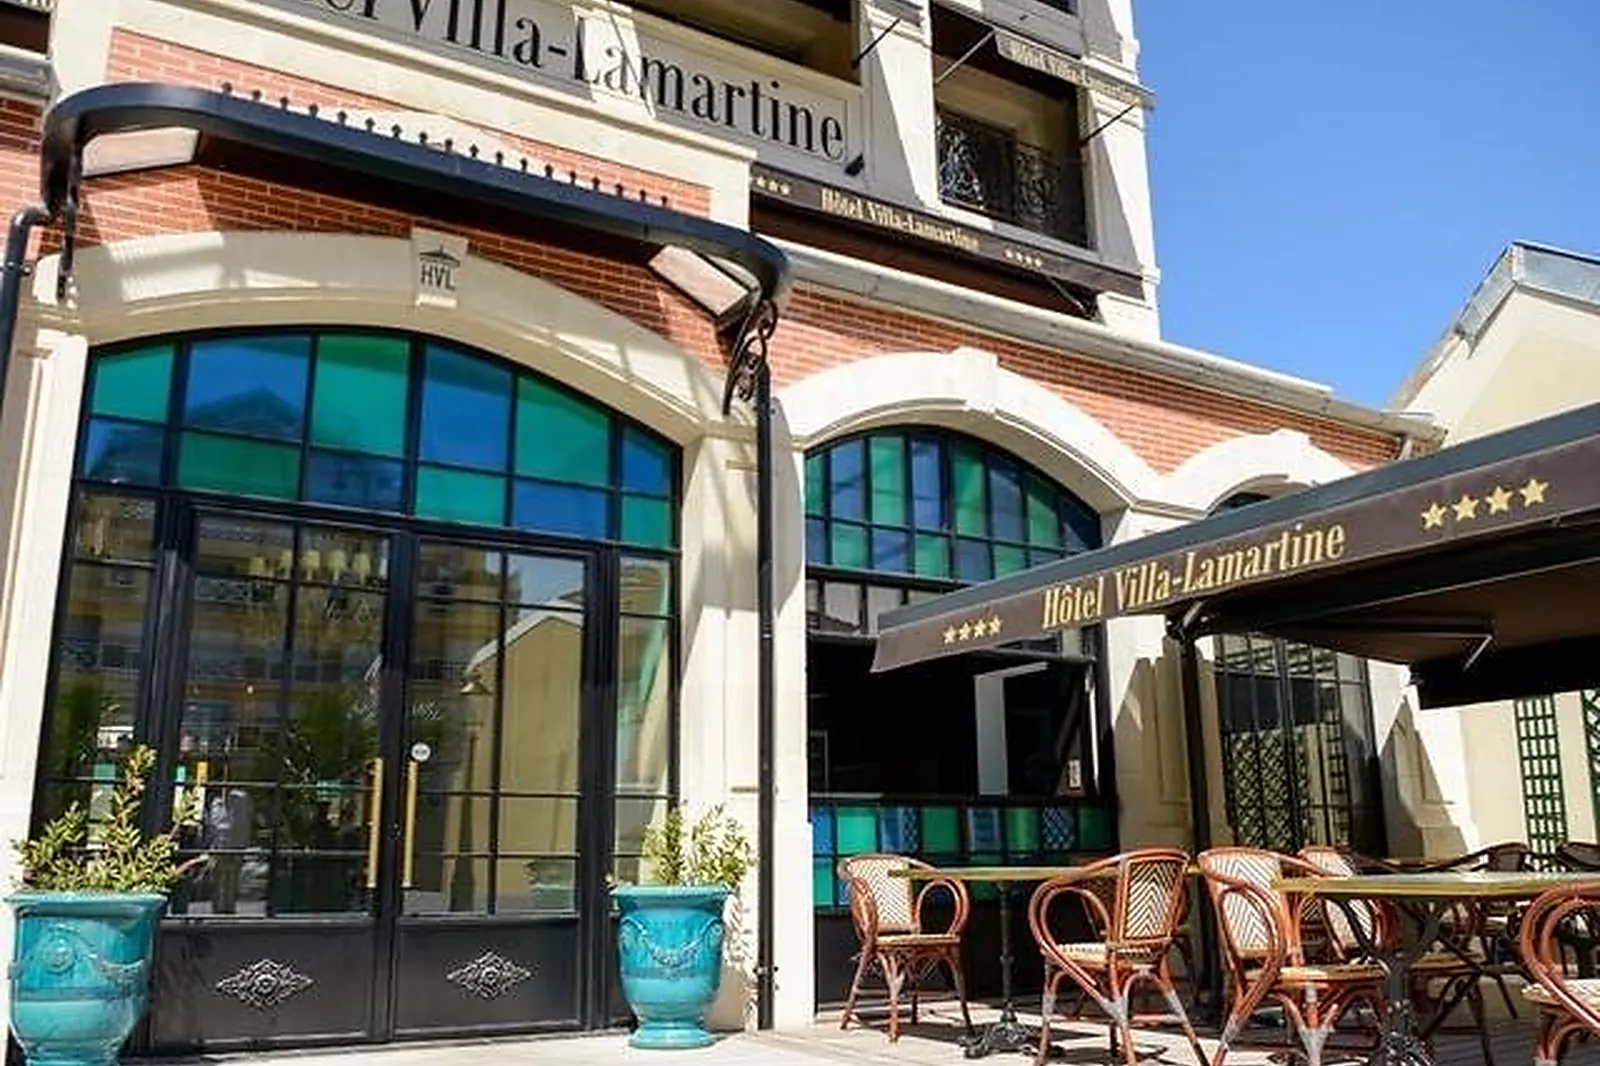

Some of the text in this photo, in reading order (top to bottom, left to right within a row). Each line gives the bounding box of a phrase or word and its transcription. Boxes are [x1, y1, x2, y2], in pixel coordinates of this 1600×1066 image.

[421, 263, 456, 291] HVL
[1042, 523, 1347, 629] Hôtel Villa-Lamartine
